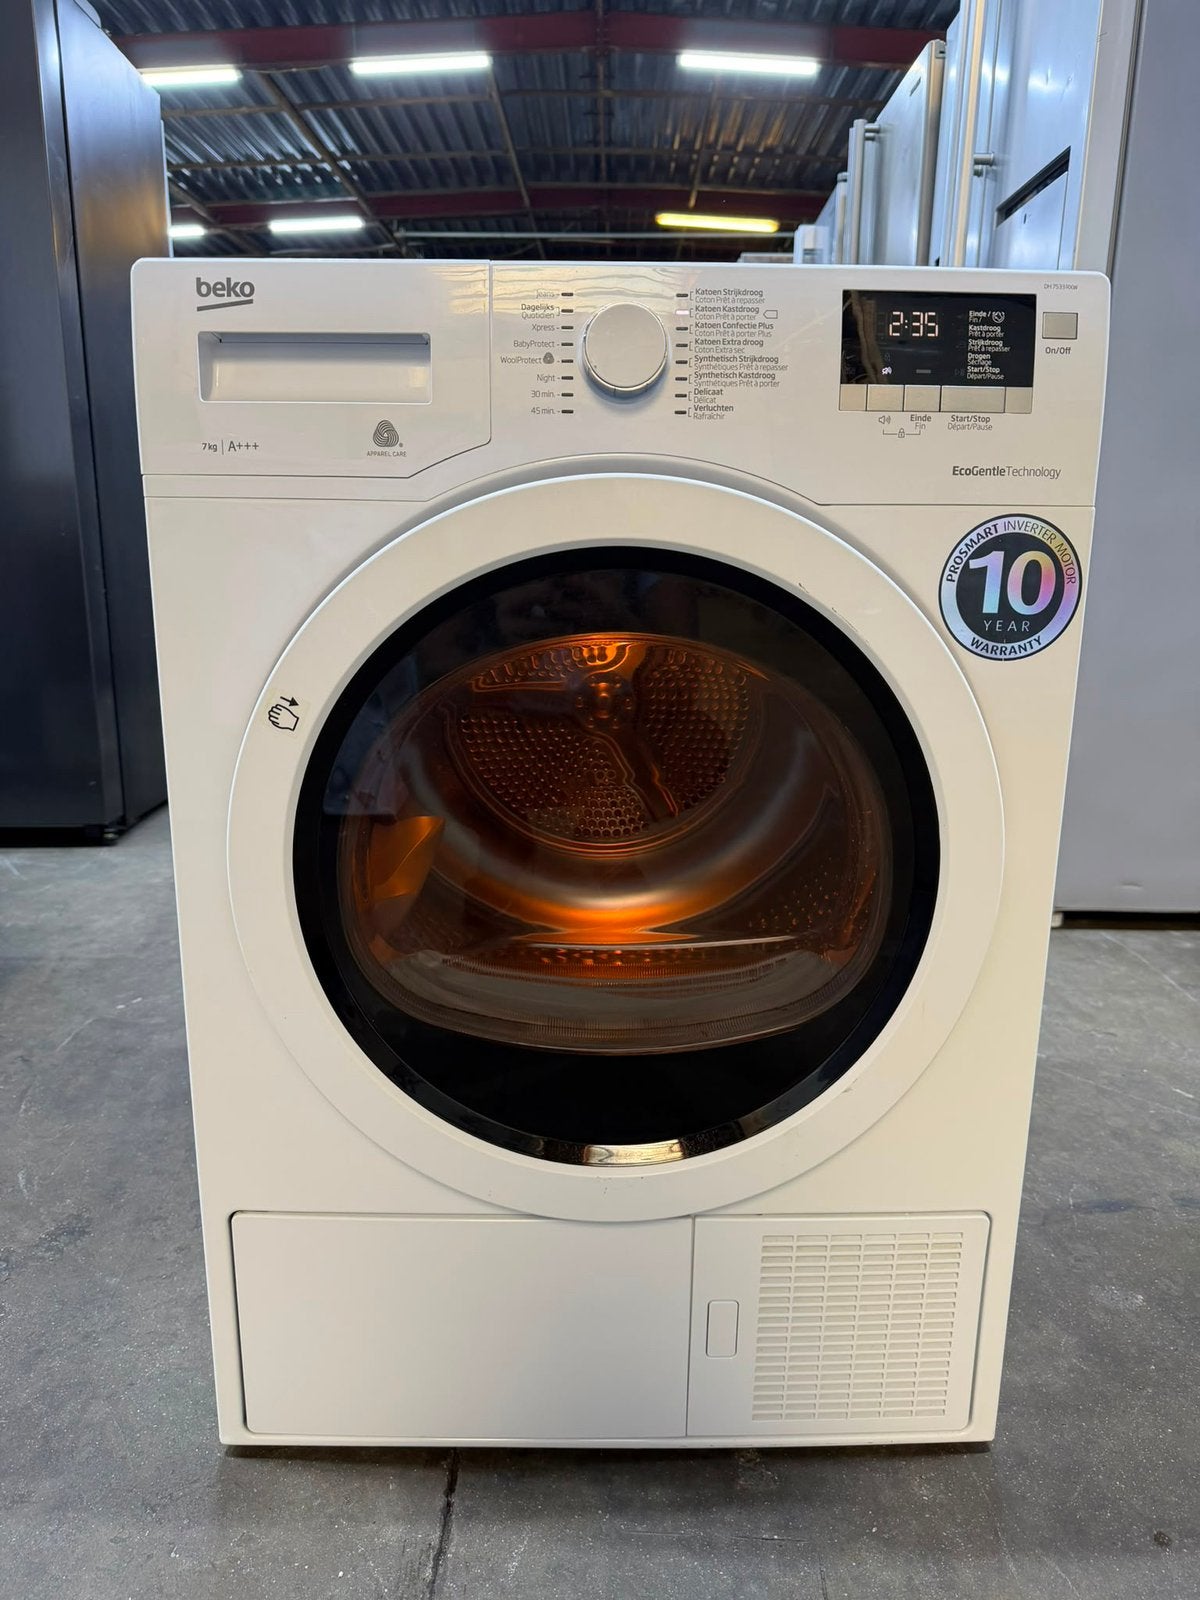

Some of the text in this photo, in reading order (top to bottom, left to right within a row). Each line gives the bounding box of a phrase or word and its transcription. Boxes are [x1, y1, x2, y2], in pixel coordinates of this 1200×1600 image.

[196, 277, 255, 298] beko
[723, 289, 763, 297] Strijkdroog
[532, 324, 555, 332] Xpress
[889, 312, 938, 336] 2:35
[514, 340, 555, 349] BabyProtect
[743, 339, 763, 347] droog
[1045, 347, 1071, 355] On/Off
[740, 356, 779, 364] Strijkdroog
[695, 363, 738, 371] Synthétiques
[537, 374, 555, 383] Night
[739, 372, 775, 380] Kastdroog
[951, 415, 990, 424] Start/Stop
[947, 423, 992, 431] Départ/Pause
[228, 441, 259, 452] A+++
[946, 520, 1076, 585] PROSMART INVERTER MOTOR
[969, 551, 1056, 615] 10
[984, 620, 1030, 632] YEAR
[971, 636, 1041, 656] WARRANTY
